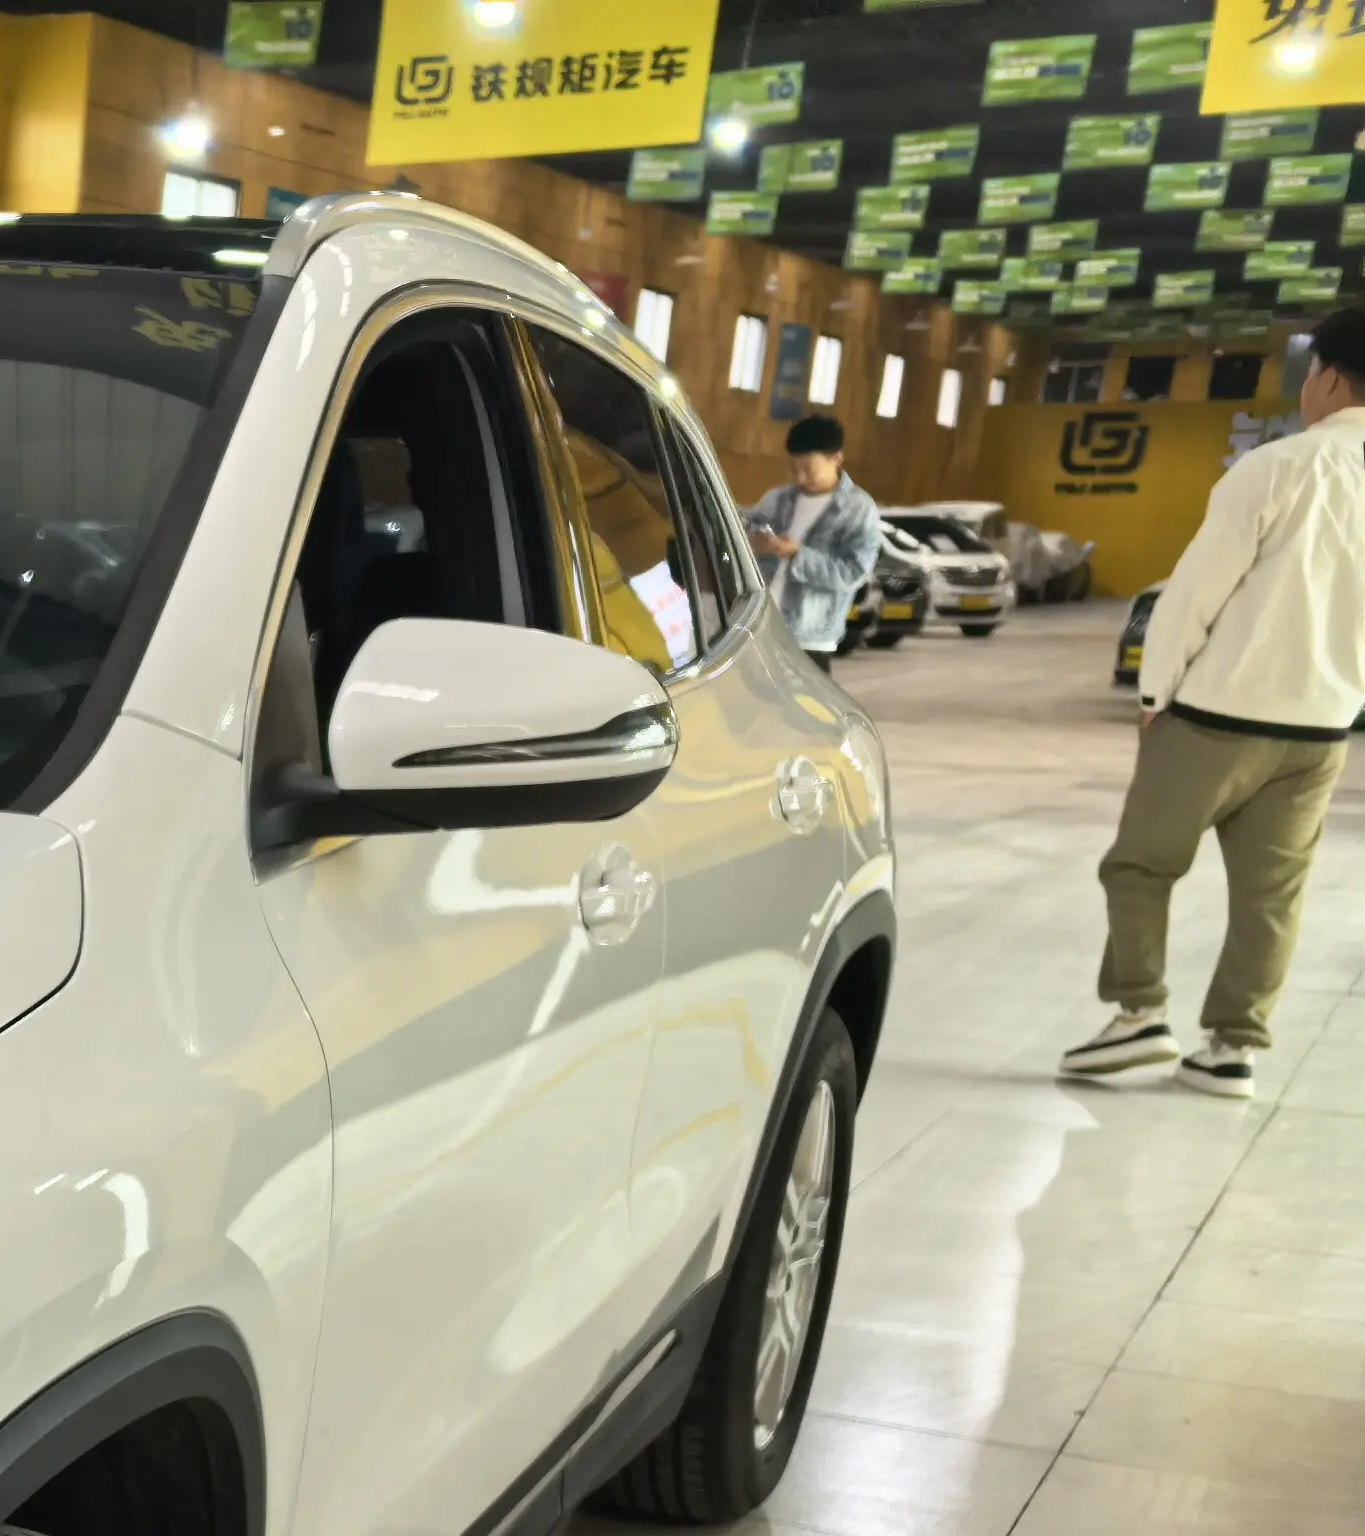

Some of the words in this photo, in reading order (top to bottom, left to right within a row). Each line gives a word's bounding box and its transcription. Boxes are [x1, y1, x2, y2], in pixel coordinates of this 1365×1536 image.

[469, 46, 689, 103] 铁规矩汽车
